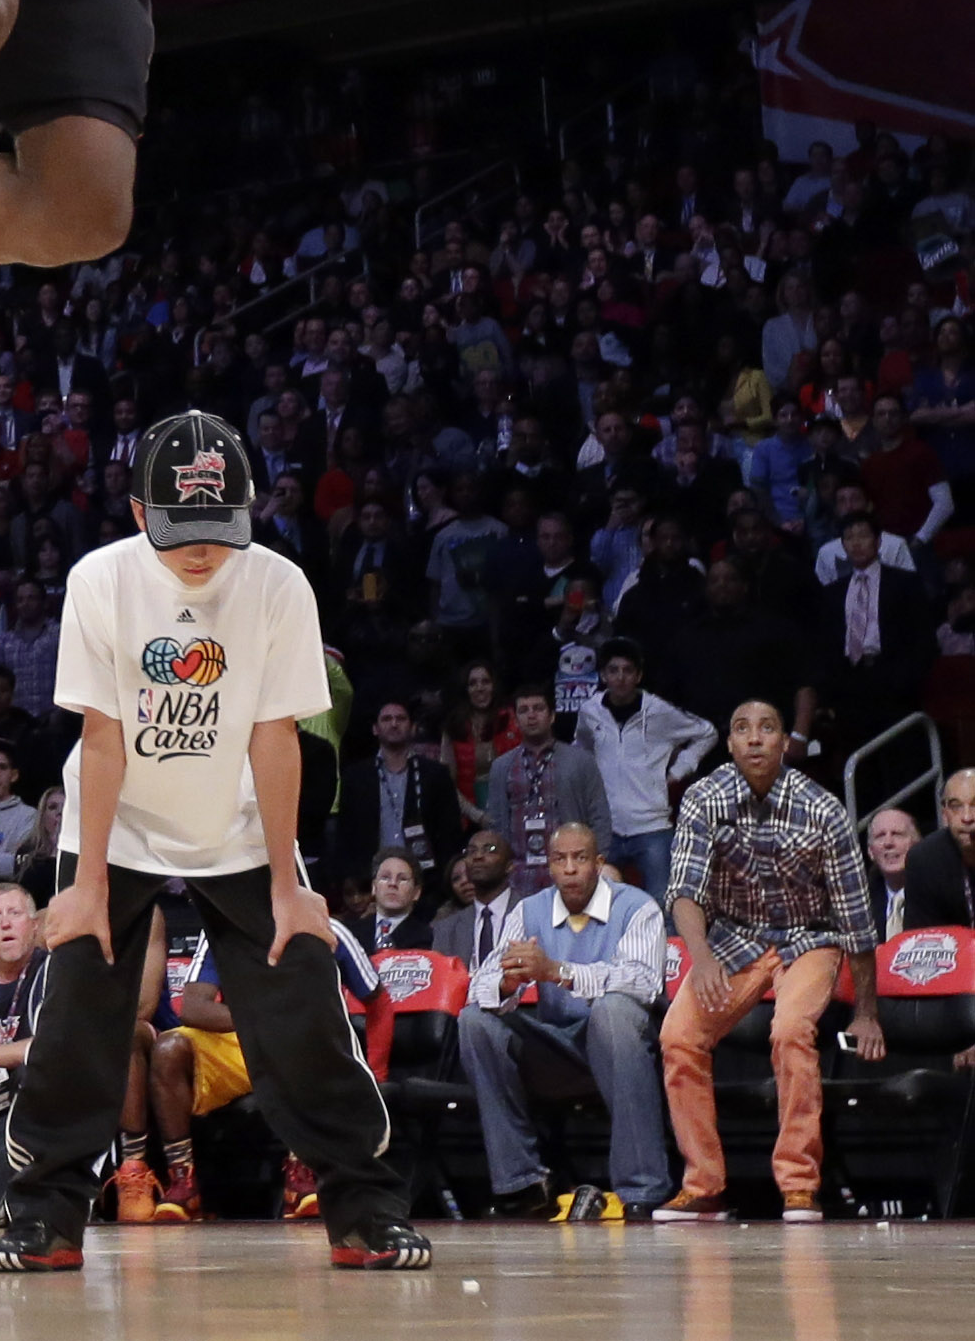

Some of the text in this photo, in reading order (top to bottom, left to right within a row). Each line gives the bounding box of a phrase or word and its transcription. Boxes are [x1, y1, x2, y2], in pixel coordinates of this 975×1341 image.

[555, 683, 598, 698] STAY
[155, 691, 220, 726] NBA
[135, 726, 218, 757] Cares
